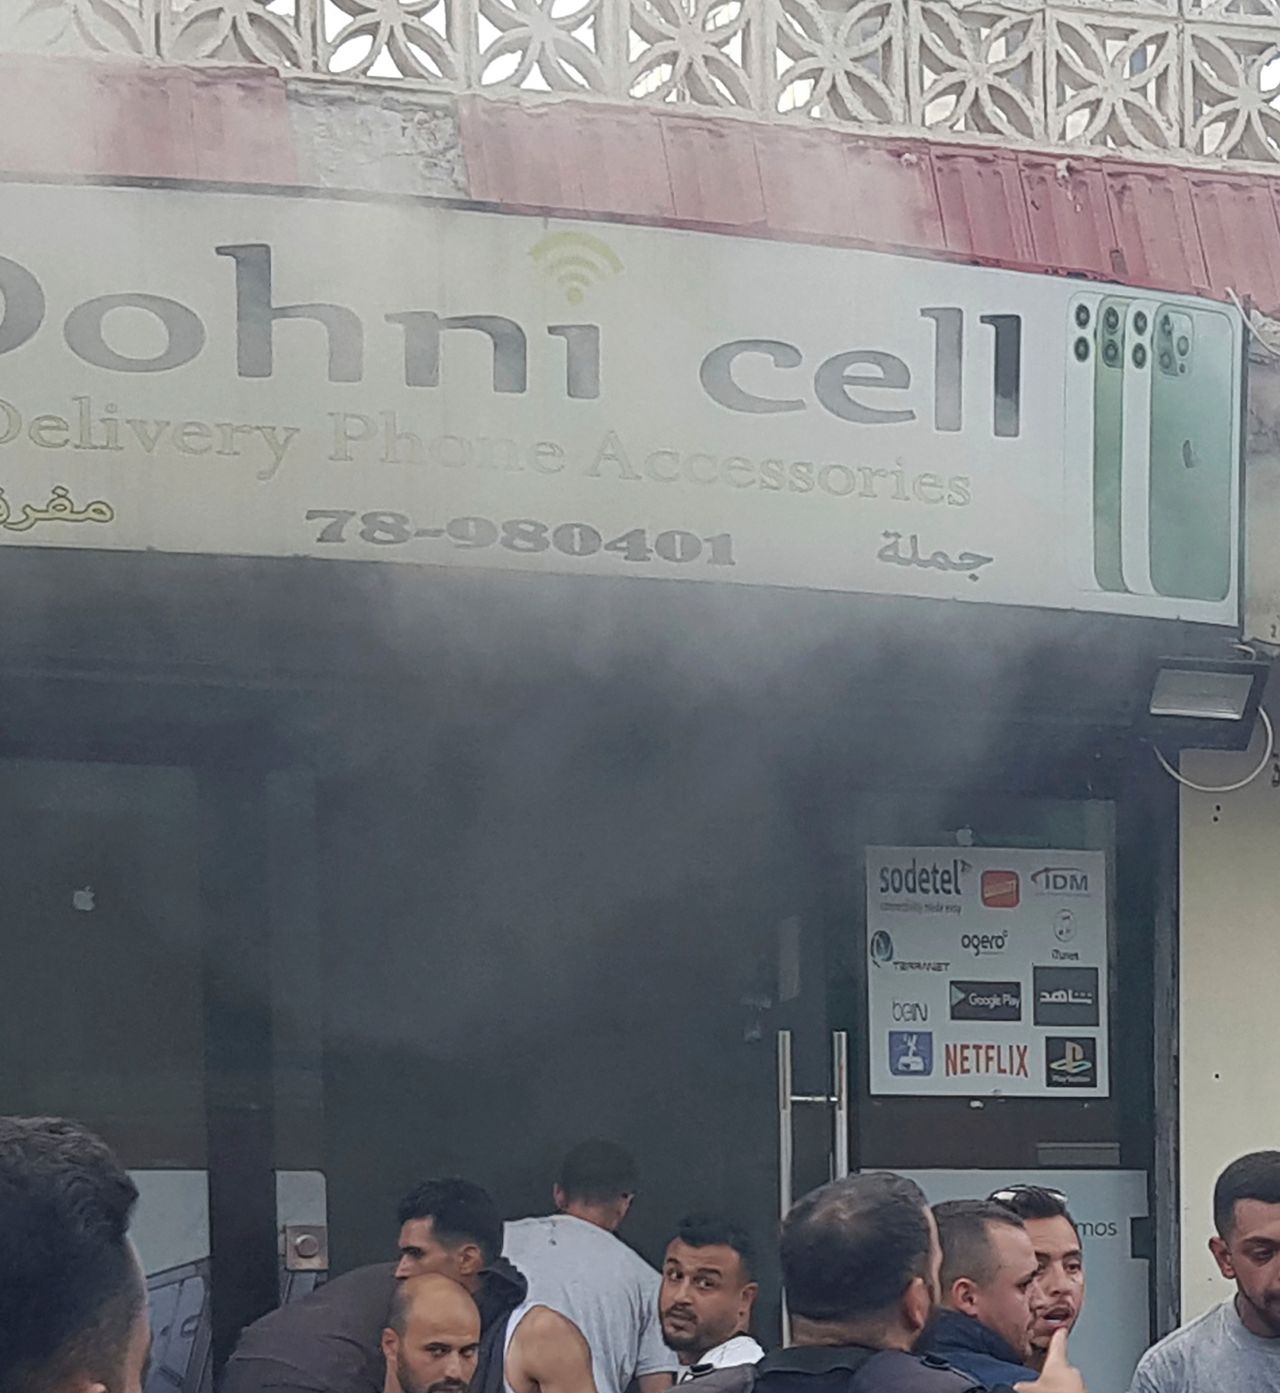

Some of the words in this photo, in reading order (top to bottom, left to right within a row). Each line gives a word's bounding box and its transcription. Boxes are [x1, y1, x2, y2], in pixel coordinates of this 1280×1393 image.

[699, 306, 1021, 438] cell
[326, 410, 566, 474] Phone
[584, 429, 972, 508] Accessories
[305, 508, 736, 567] 78-980401
[876, 528, 994, 582] جملة
[879, 858, 962, 896] sodetel
[1044, 872, 1090, 892] IDM
[961, 933, 1006, 957] ogero
[969, 992, 1001, 1009] Google
[1039, 988, 1092, 1005] شاهد
[945, 1043, 1029, 1078] NETFLIX
